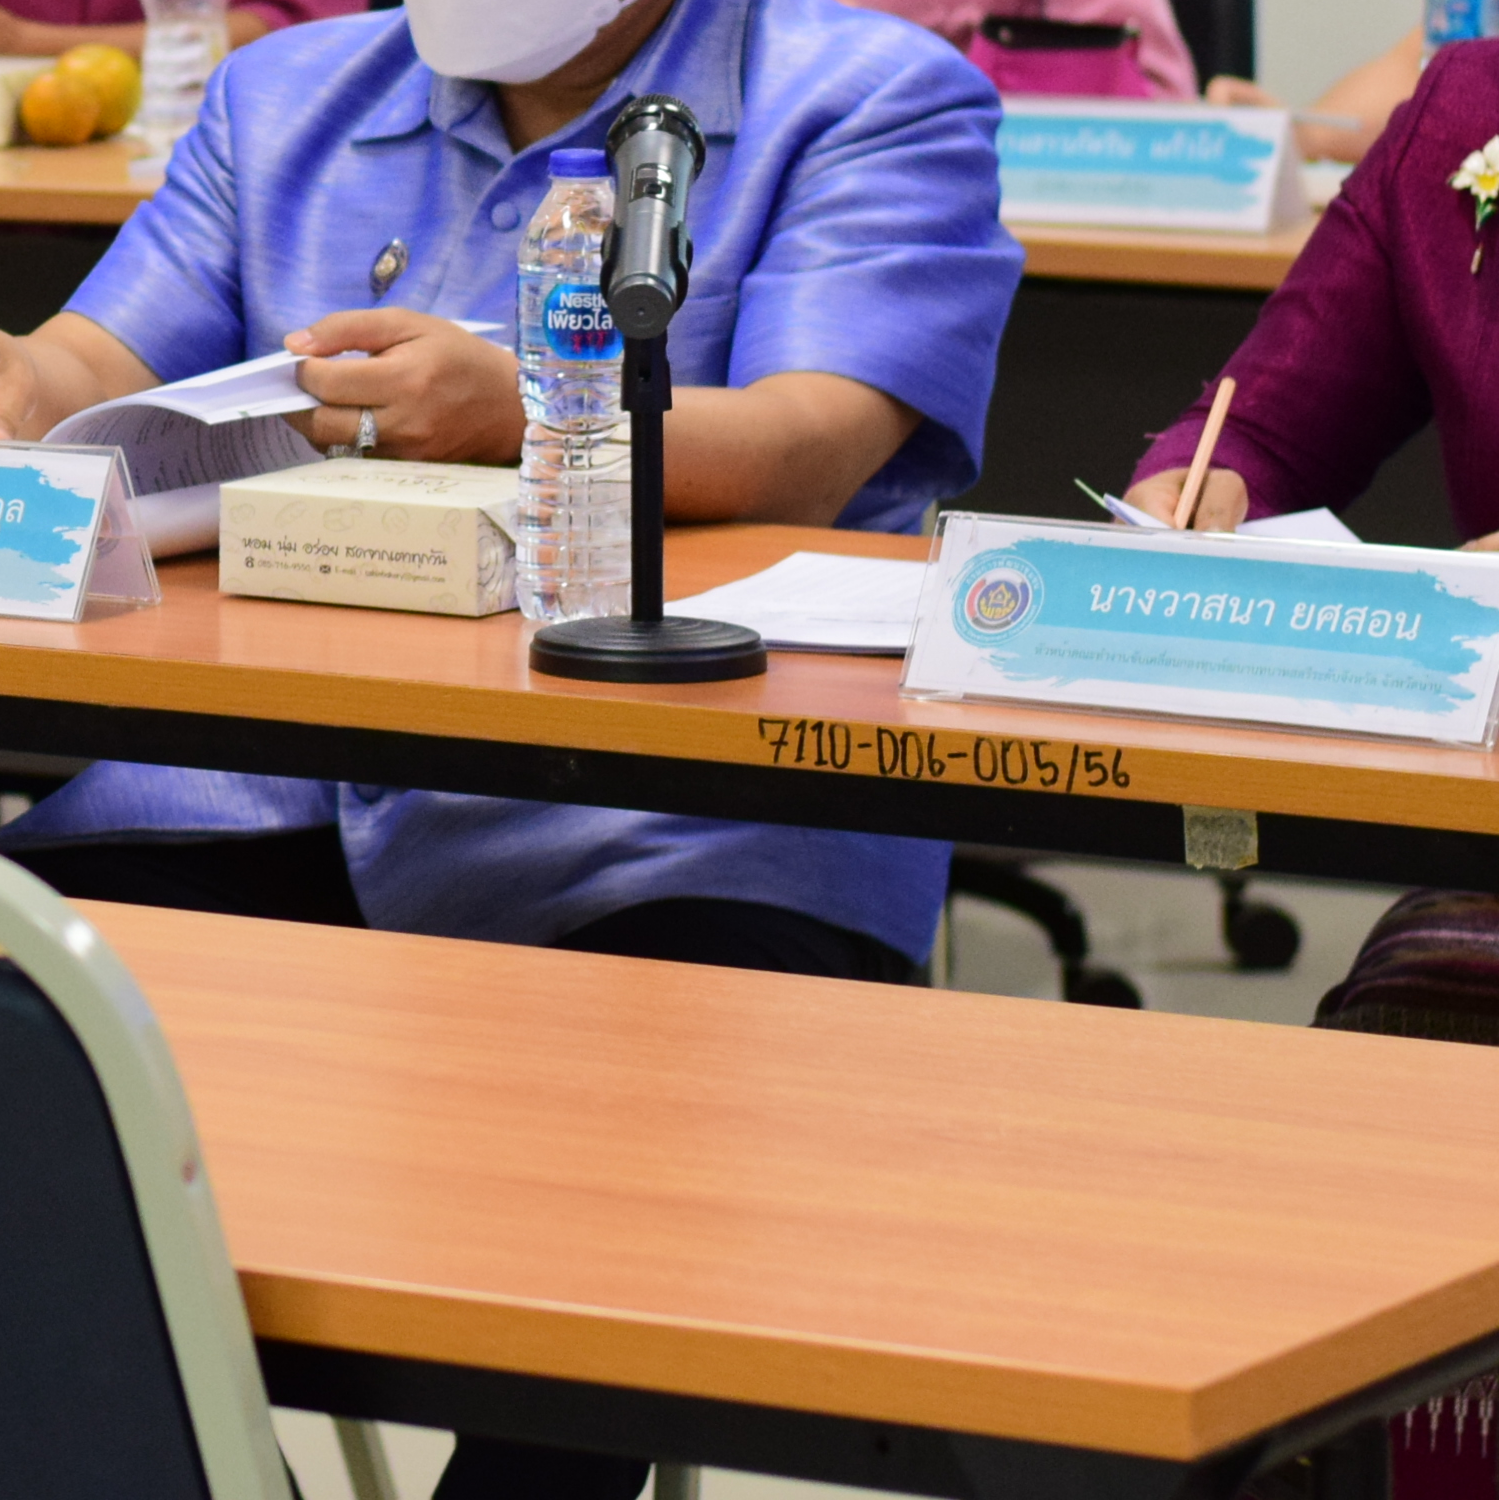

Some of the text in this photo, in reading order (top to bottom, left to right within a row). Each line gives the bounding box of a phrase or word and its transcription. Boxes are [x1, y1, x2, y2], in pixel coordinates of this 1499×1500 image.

[548, 308, 613, 330] เพียวไล
[242, 535, 447, 569] หอม นุ่ม อร่อย สดจากเตาทุกวัน
[1090, 583, 1422, 641] นางวาสนา ยศสอน
